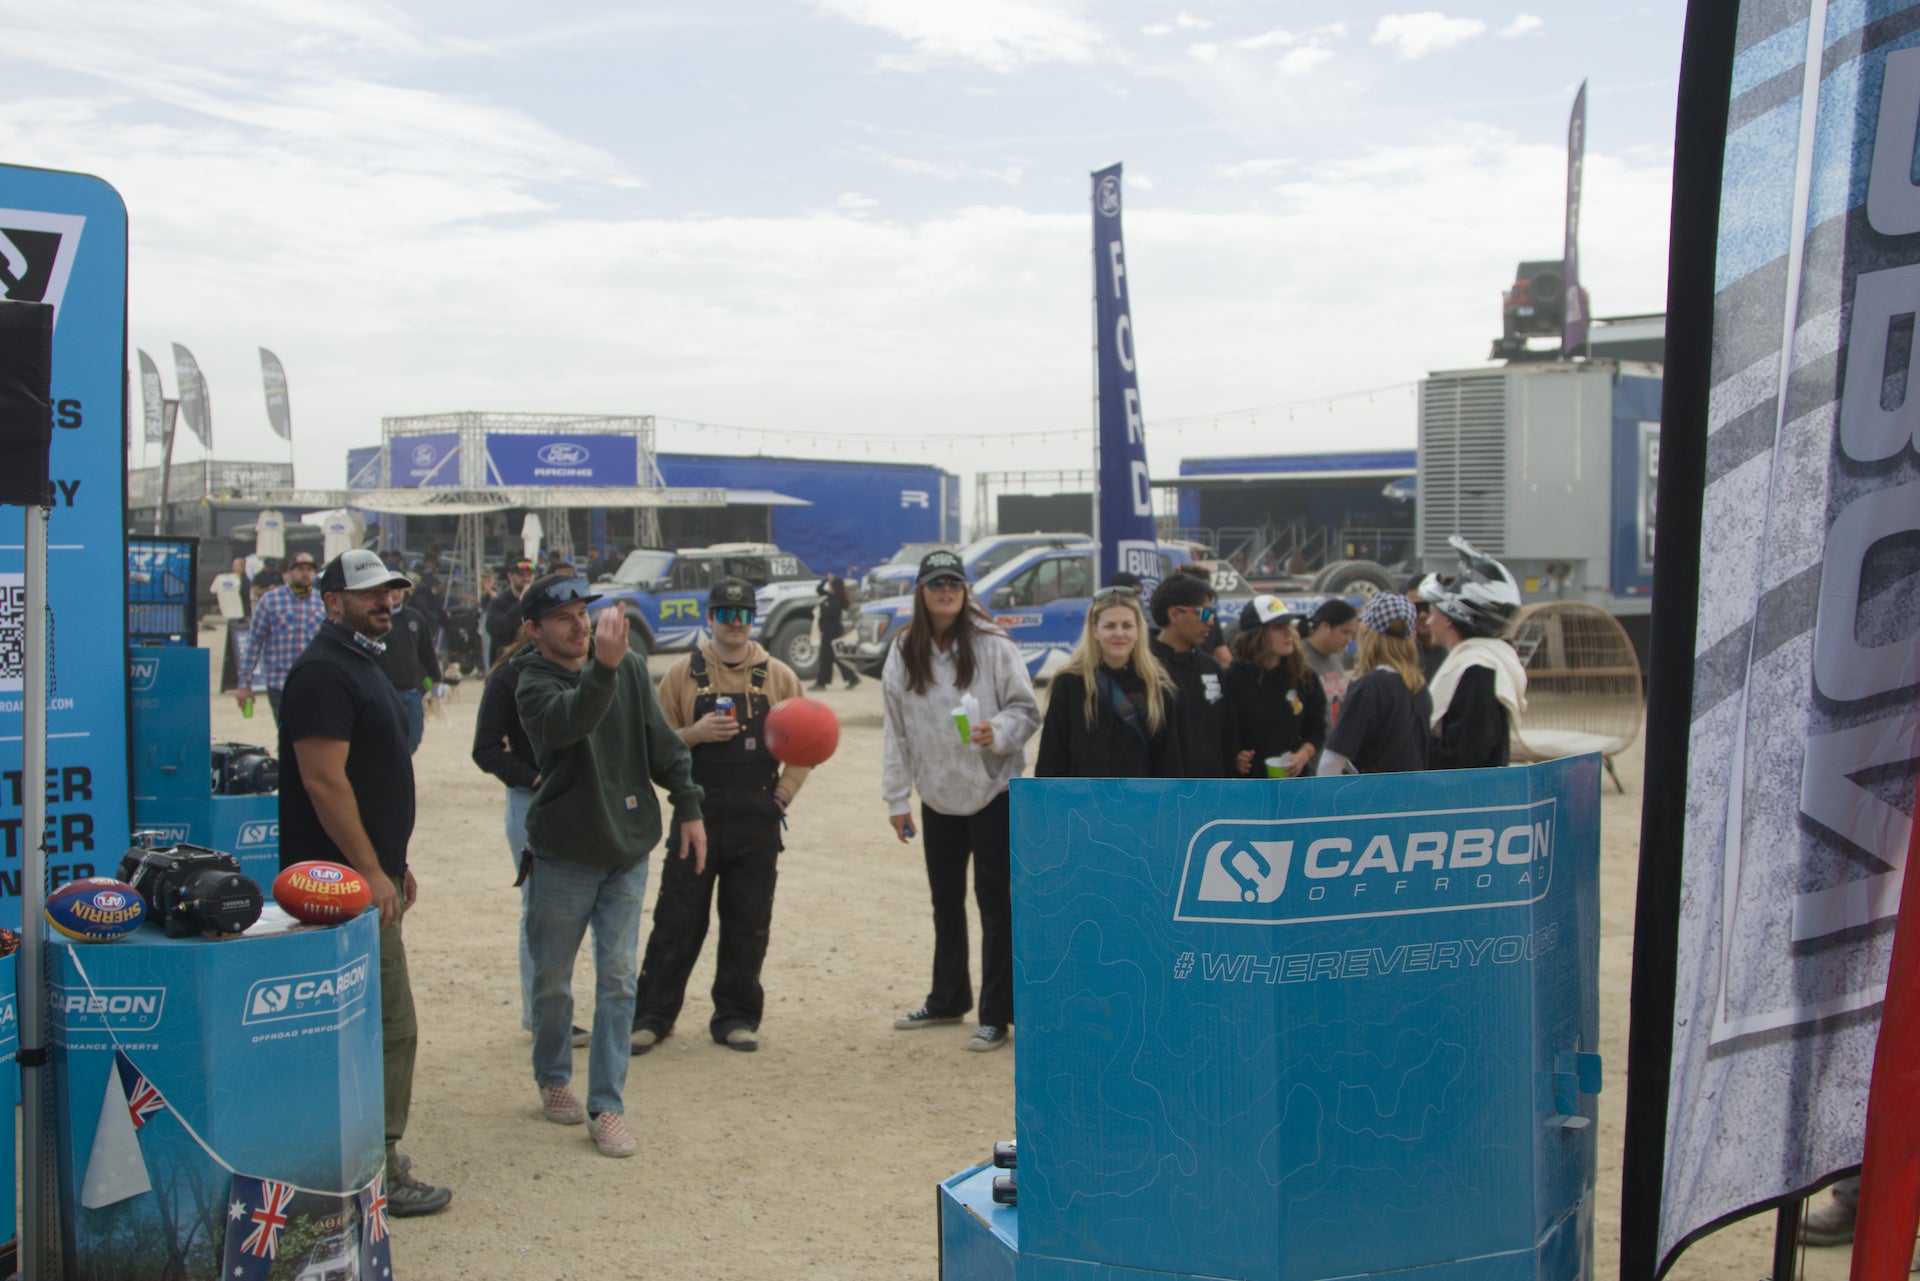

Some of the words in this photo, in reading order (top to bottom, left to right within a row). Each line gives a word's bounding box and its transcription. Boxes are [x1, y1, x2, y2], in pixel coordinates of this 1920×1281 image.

[51, 398, 82, 429] S
[534, 467, 593, 477] RACING
[1128, 551, 1159, 576] BUIL
[1210, 571, 1239, 591] 135
[659, 599, 700, 619] RTR
[1304, 819, 1551, 879] CARBON
[288, 873, 361, 895] SHERRIN
[1309, 866, 1546, 901] OFFROAD
[70, 900, 142, 923] SHERRIN
[294, 964, 366, 1000] CARBON
[252, 1030, 298, 1043] OFFROAD
